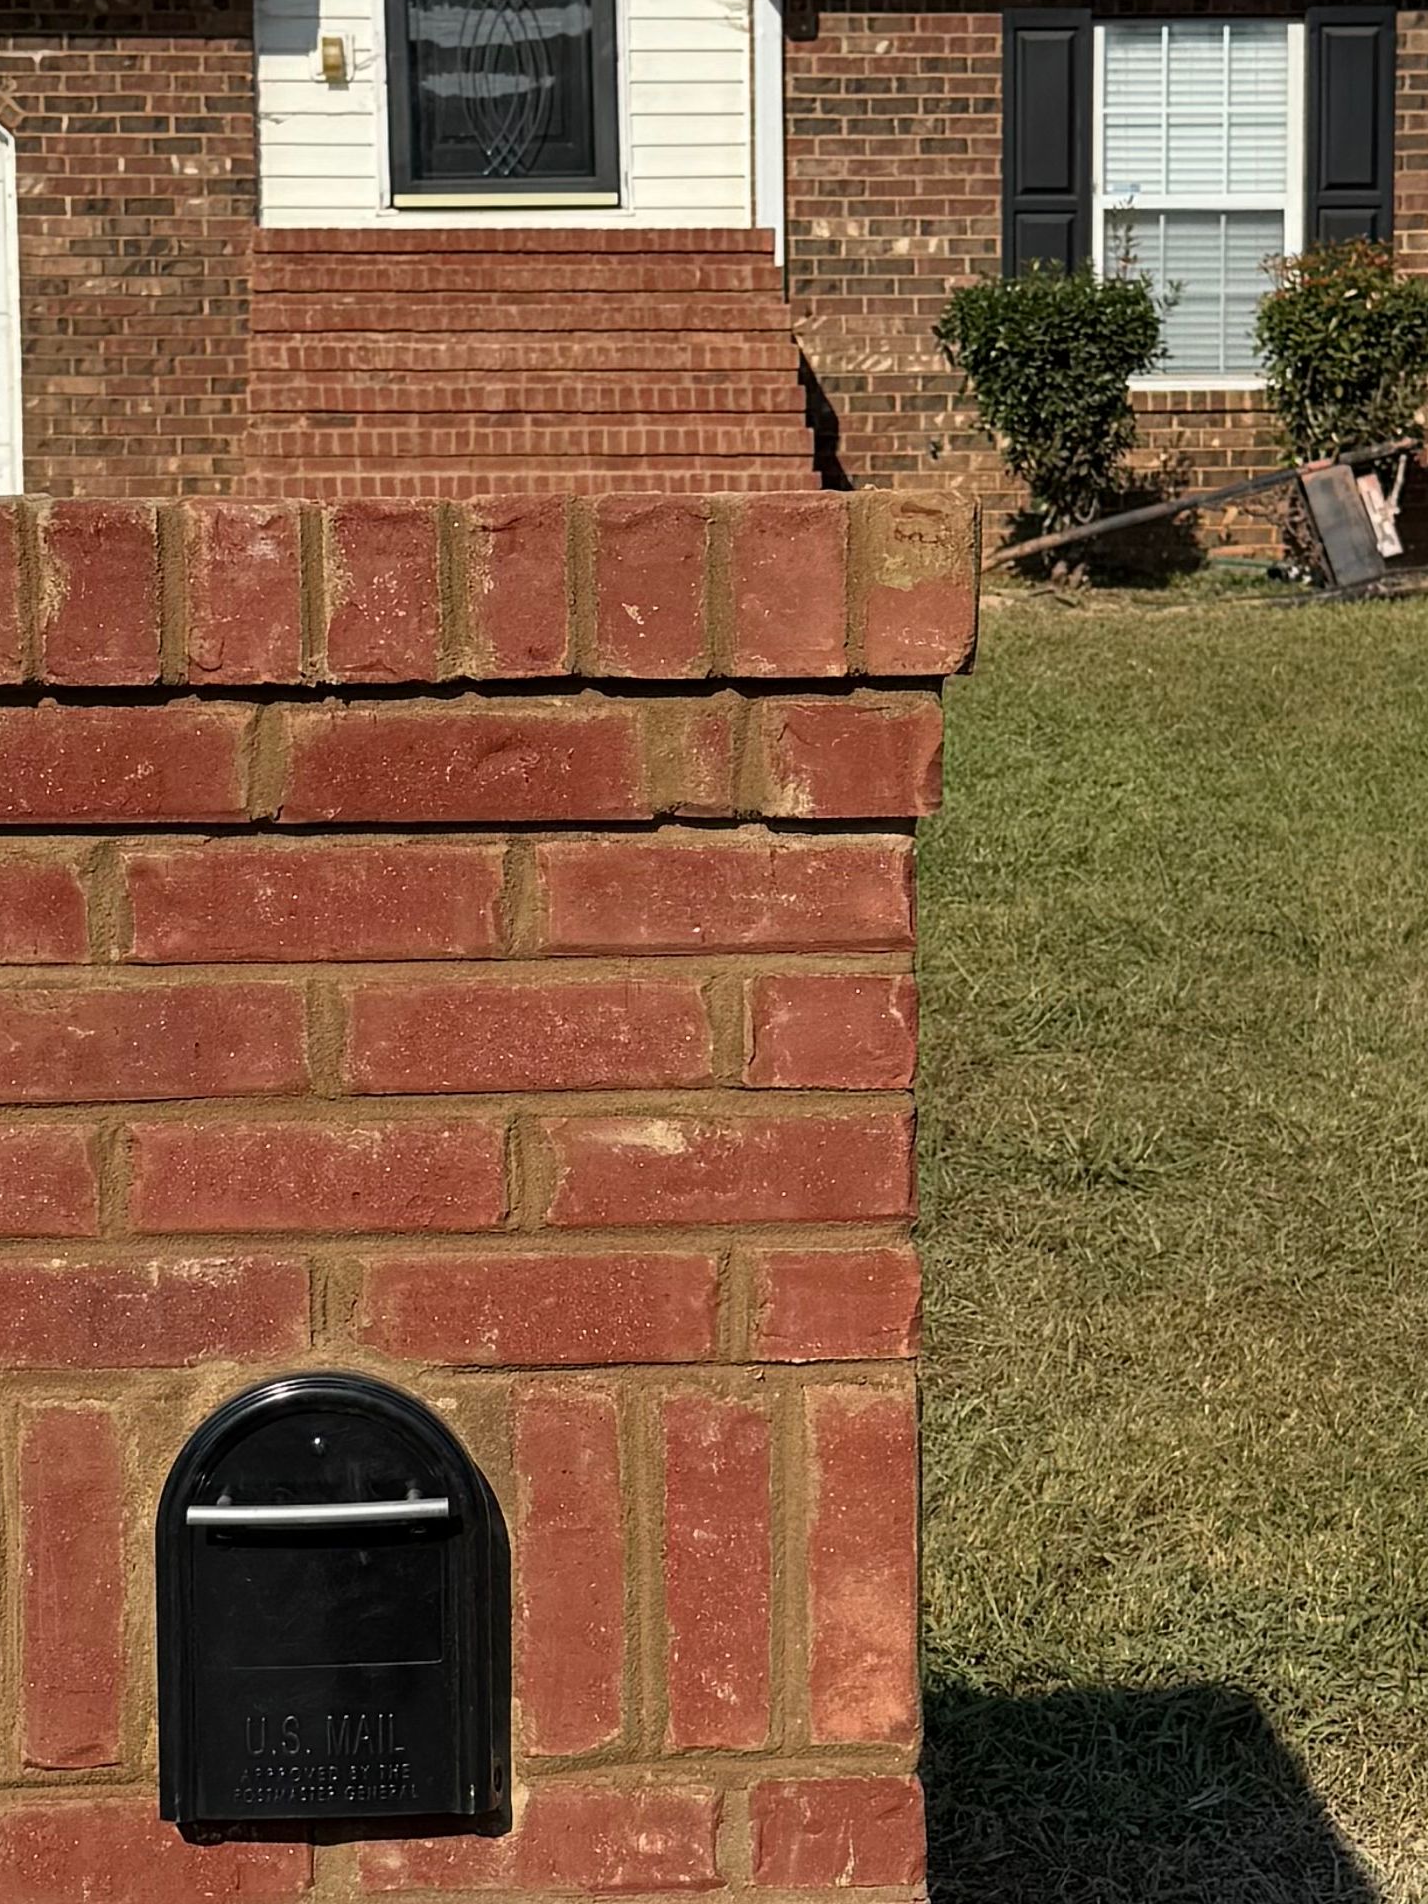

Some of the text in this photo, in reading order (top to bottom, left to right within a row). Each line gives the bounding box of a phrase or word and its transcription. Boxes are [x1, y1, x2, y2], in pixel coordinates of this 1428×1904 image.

[246, 1712, 405, 1755] U.S. MAIL
[240, 1762, 411, 1783] APPROVED BY THE
[233, 1783, 420, 1803] POSTMASTER GENERAL
